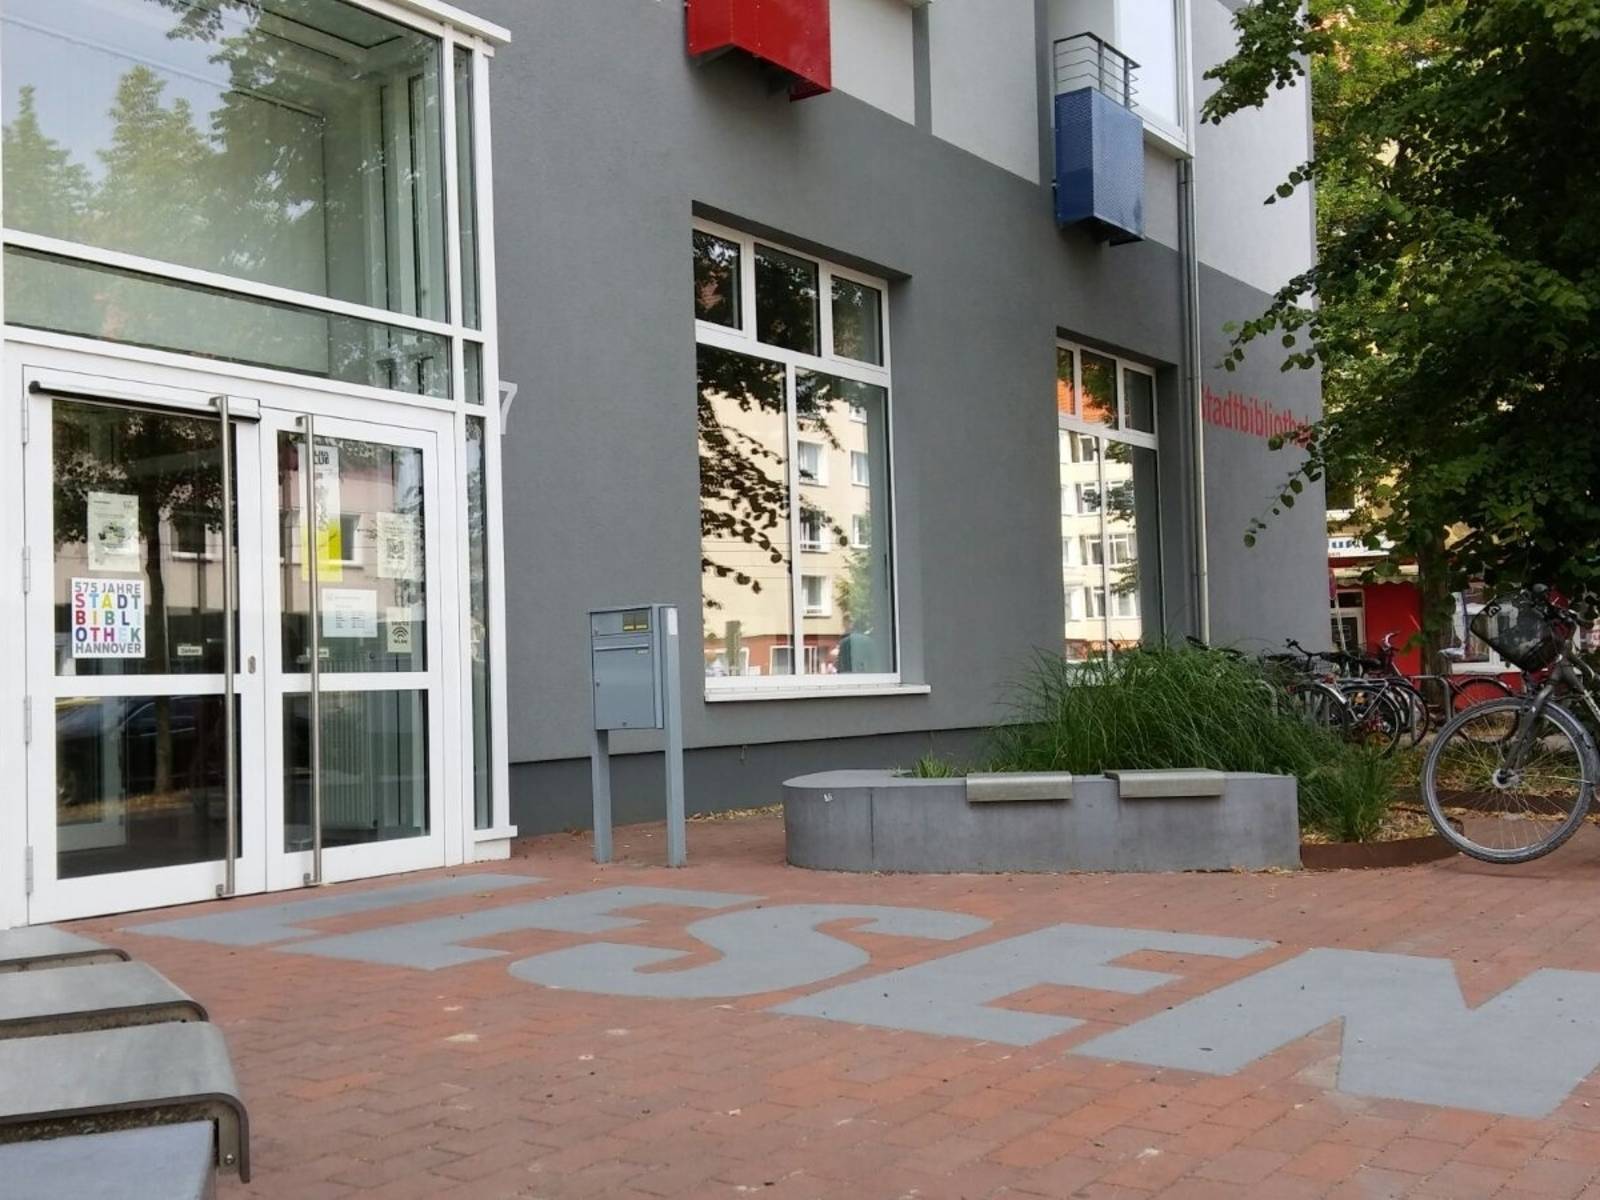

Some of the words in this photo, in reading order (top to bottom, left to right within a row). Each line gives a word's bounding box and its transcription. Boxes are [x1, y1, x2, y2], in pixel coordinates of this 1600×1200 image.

[75, 582, 97, 593] 575
[102, 582, 141, 595] JAHRE
[75, 592, 141, 610] STADT
[75, 626, 141, 643] OTHEK
[75, 642, 141, 654] HANNOVER
[122, 872, 1600, 1120] LESEN
